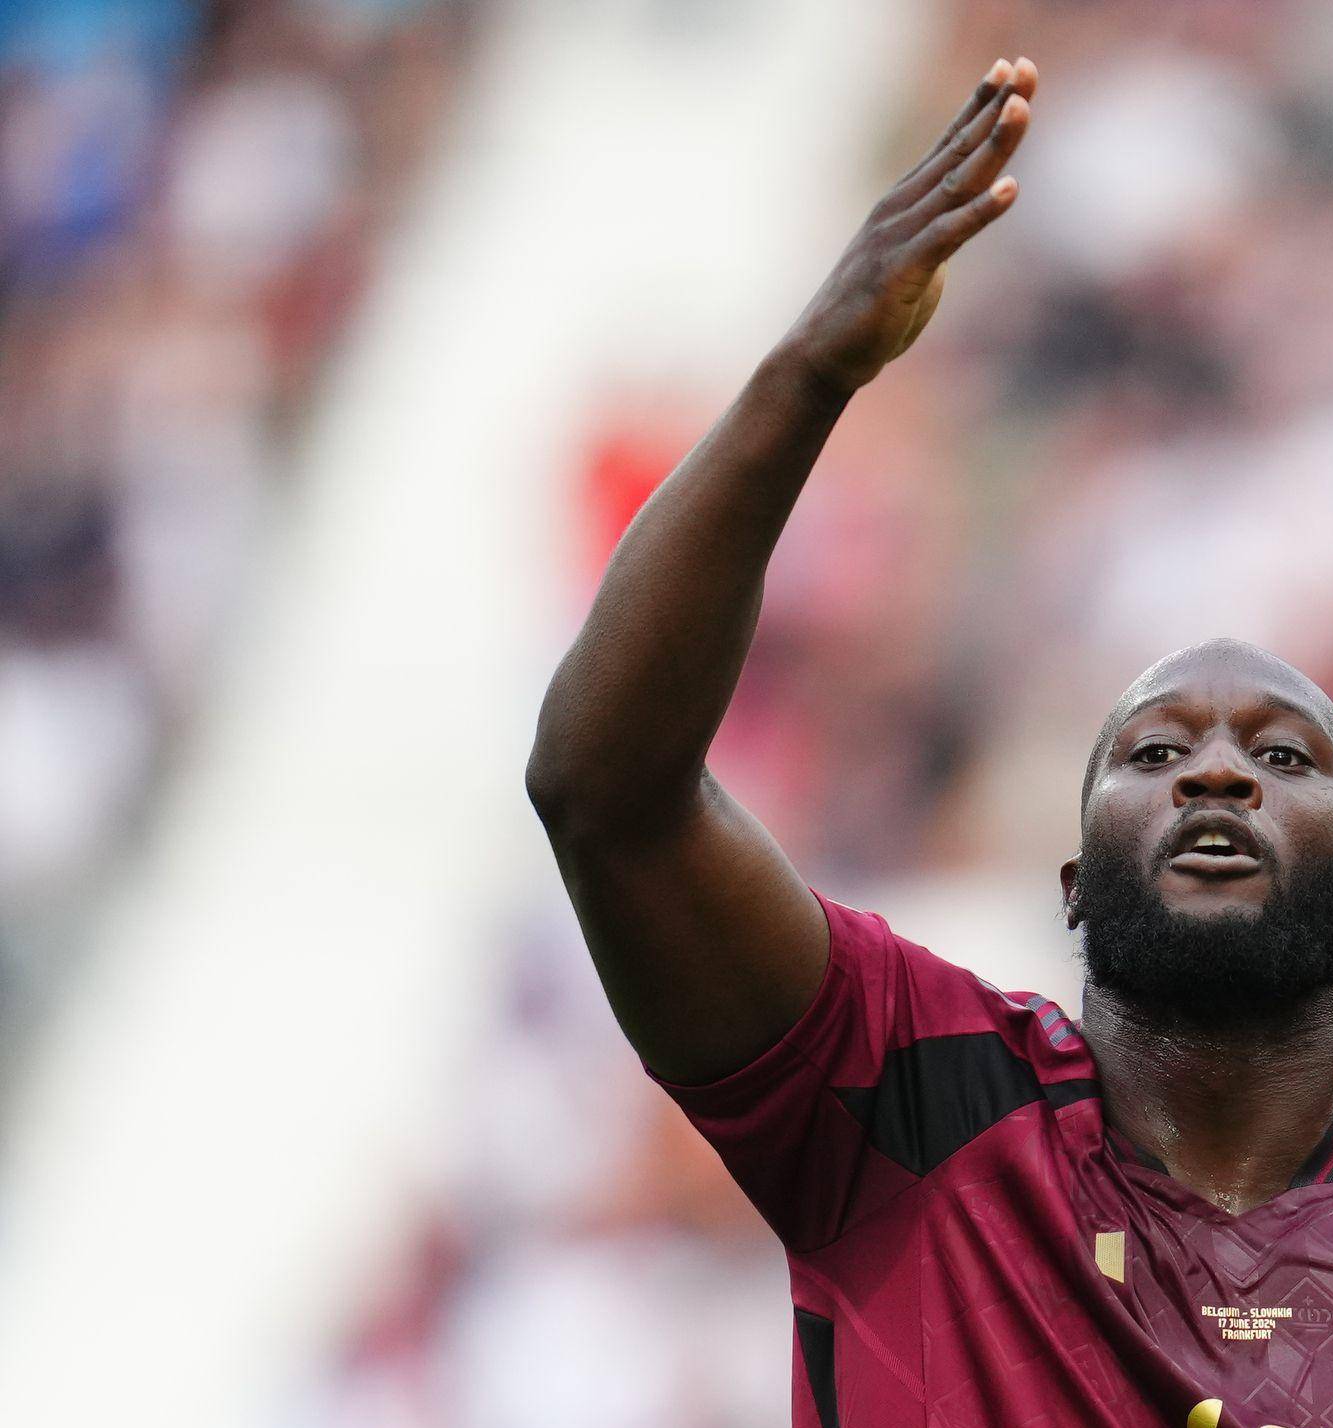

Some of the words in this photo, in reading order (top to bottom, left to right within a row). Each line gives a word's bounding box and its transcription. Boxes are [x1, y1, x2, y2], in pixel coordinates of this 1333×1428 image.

[1201, 1306, 1240, 1317] BELGIUM
[1250, 1307, 1293, 1318] SLOVAKIA
[1218, 1318, 1227, 1328] 17
[1229, 1318, 1251, 1329] JUNE
[1252, 1318, 1276, 1329] 2024
[1222, 1329, 1273, 1340] FRANKFURT
